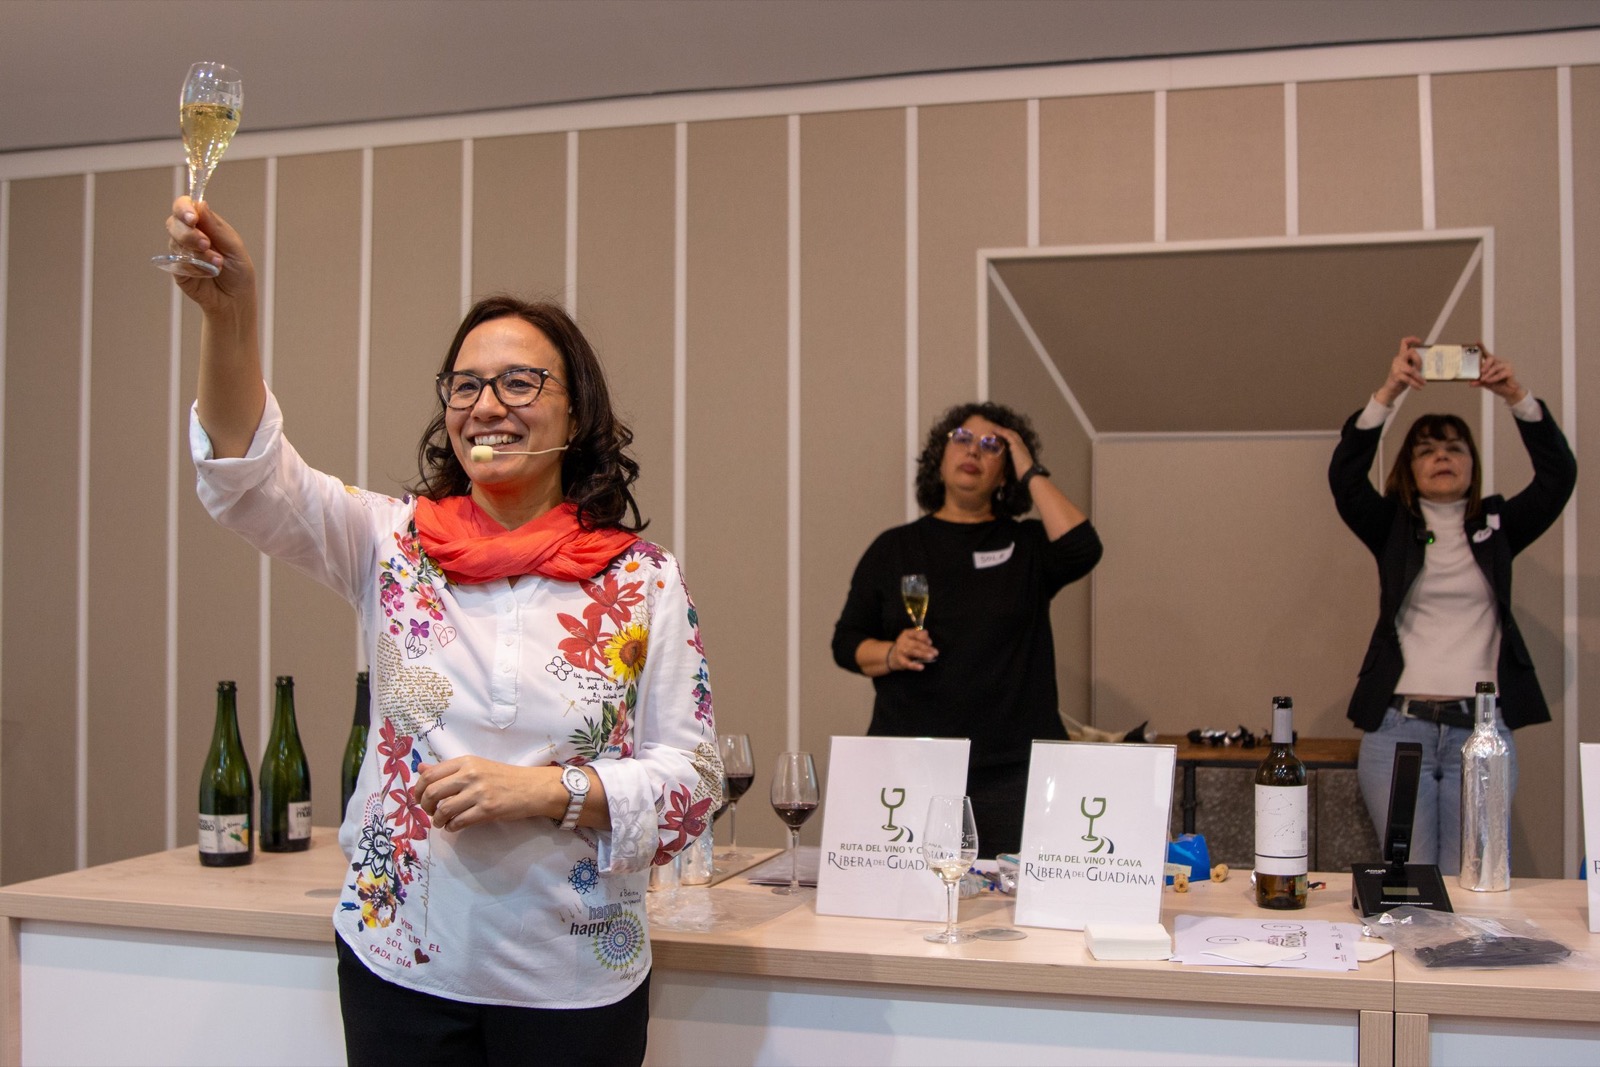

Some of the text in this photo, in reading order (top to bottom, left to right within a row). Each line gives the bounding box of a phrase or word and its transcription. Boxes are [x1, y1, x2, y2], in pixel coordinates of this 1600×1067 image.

[840, 843, 863, 852] RUTA
[865, 844, 881, 853] DEL
[884, 845, 906, 854] VINO
[908, 846, 915, 854] Y
[873, 858, 886, 866] DEL
[1038, 853, 1143, 868] RUTA DEL VINO Y CAVA
[1072, 870, 1085, 878] DEL
[401, 917, 413, 931] VER
[570, 920, 613, 938] happy
[385, 936, 402, 951] SOL
[428, 943, 442, 953] EL
[369, 944, 412, 969] CADA DÍA
